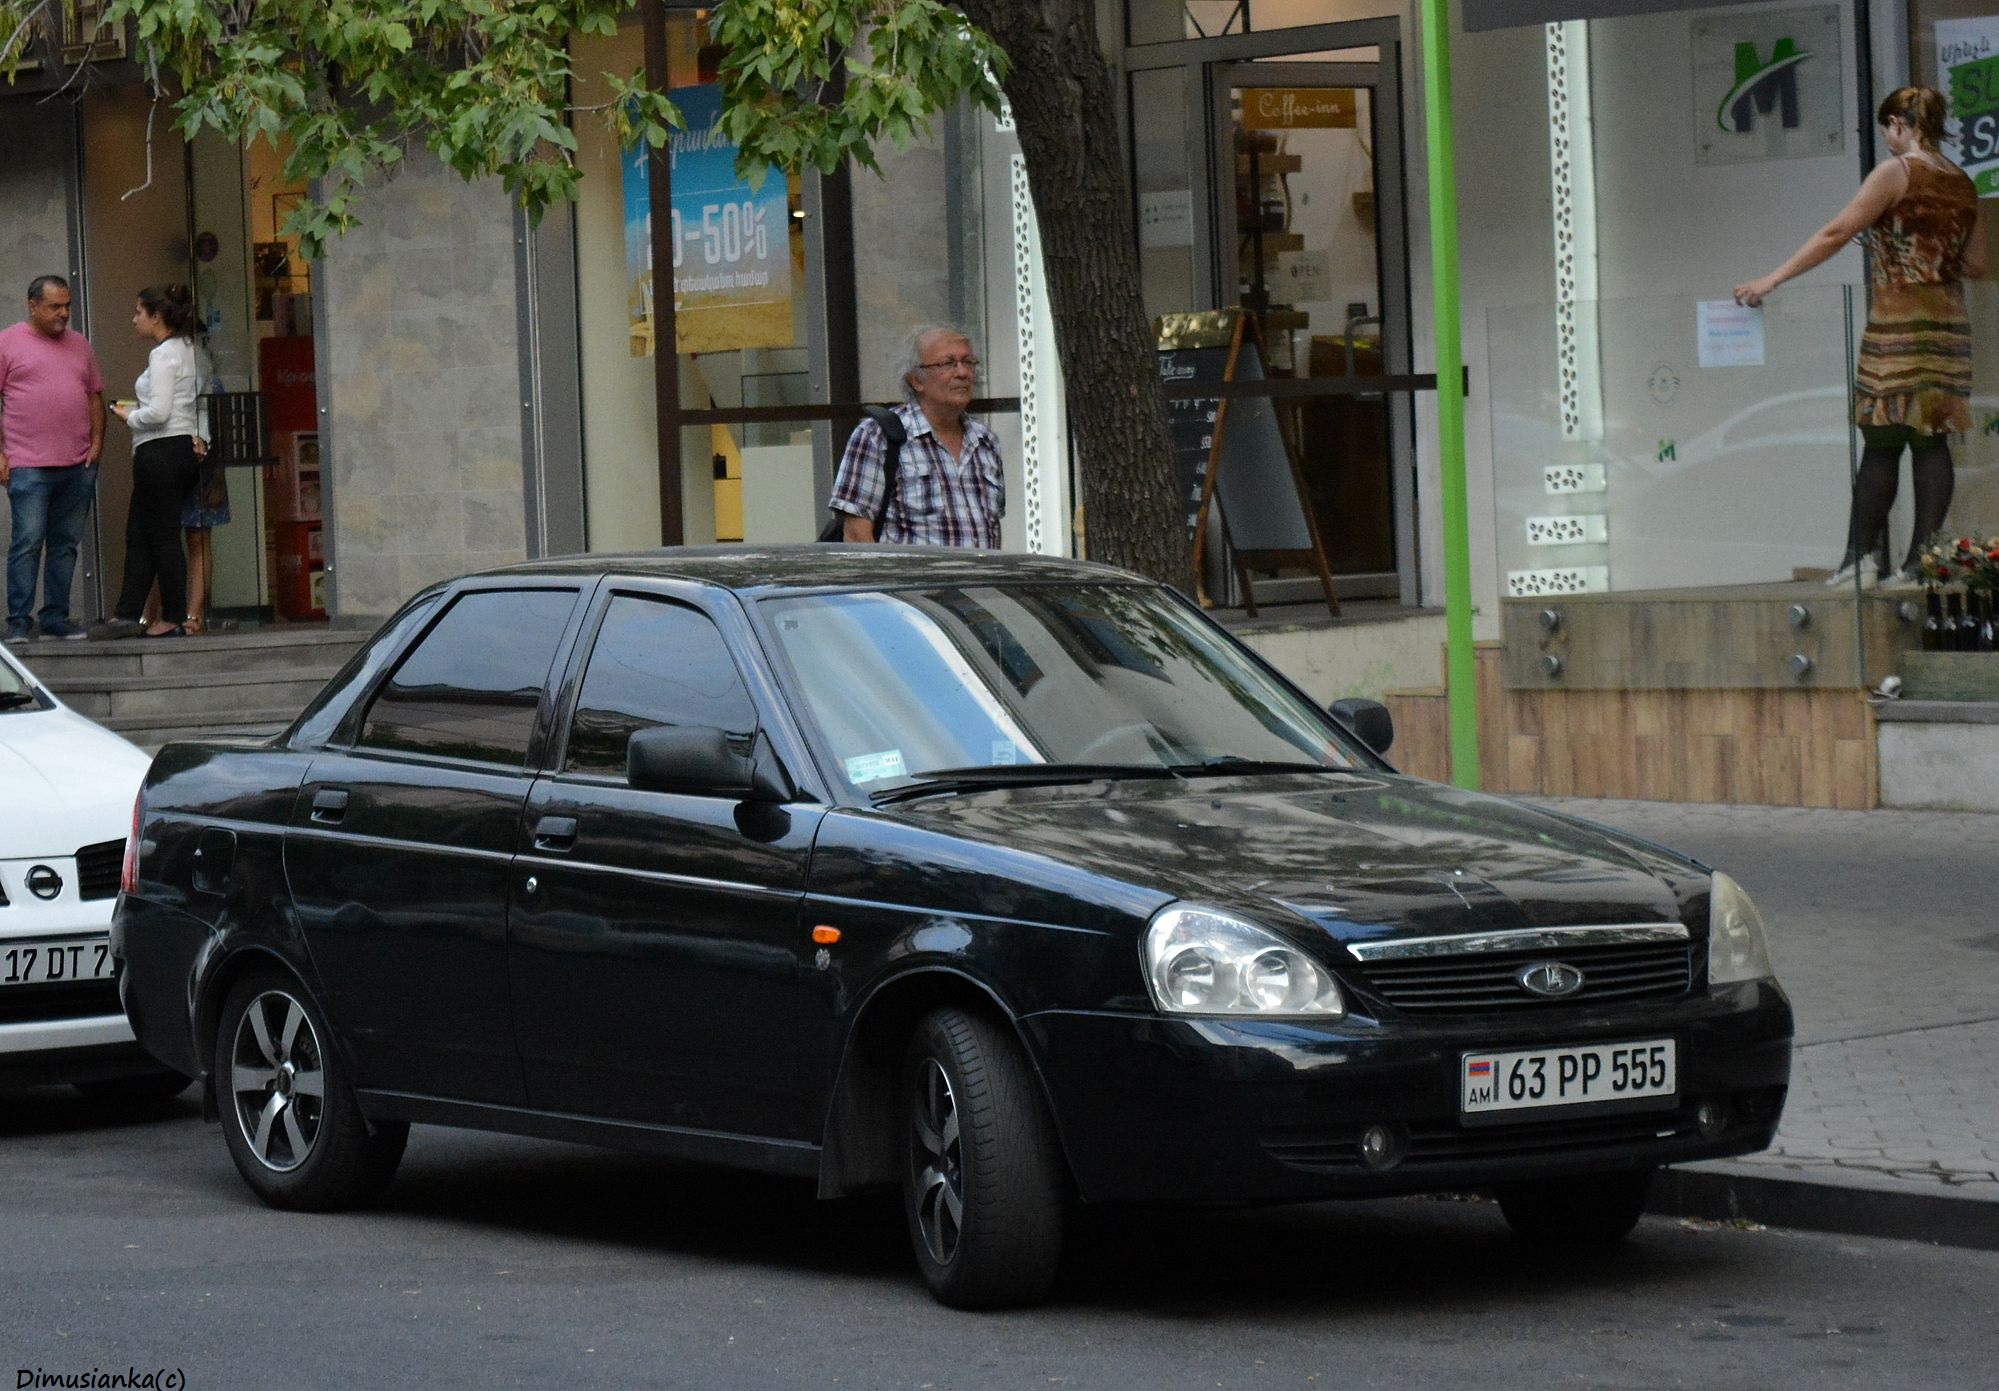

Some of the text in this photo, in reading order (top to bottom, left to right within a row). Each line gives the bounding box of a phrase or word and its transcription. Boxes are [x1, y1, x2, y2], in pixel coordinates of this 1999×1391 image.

[5, 948, 37, 981] 17
[46, 946, 84, 979] DT
[1508, 1046, 1665, 1100] 63 PP 555
[1468, 1086, 1490, 1106] AM
